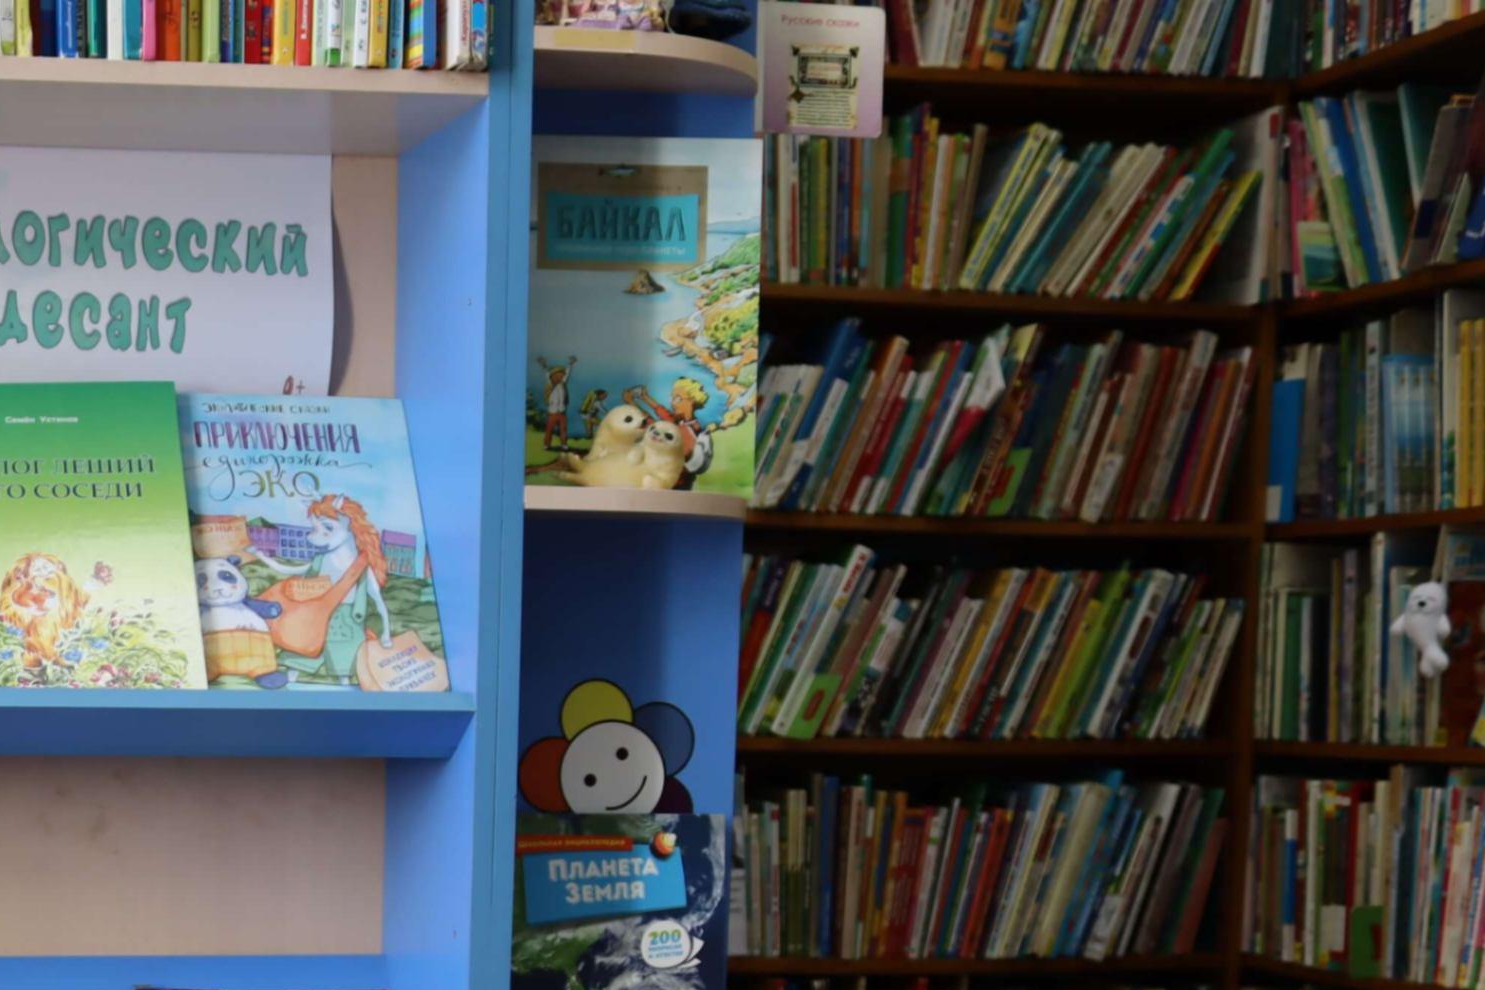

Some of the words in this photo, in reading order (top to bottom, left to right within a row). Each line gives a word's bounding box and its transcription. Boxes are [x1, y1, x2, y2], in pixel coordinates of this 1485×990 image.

[557, 199, 685, 241] БАЙКАЛ
[282, 376, 306, 395] 0+
[193, 421, 361, 453] ПРИКЛЮЧЕНИЯ
[34, 482, 143, 500] СОСЕДИ
[239, 469, 323, 498] ЭКО
[649, 929, 682, 945] 200
